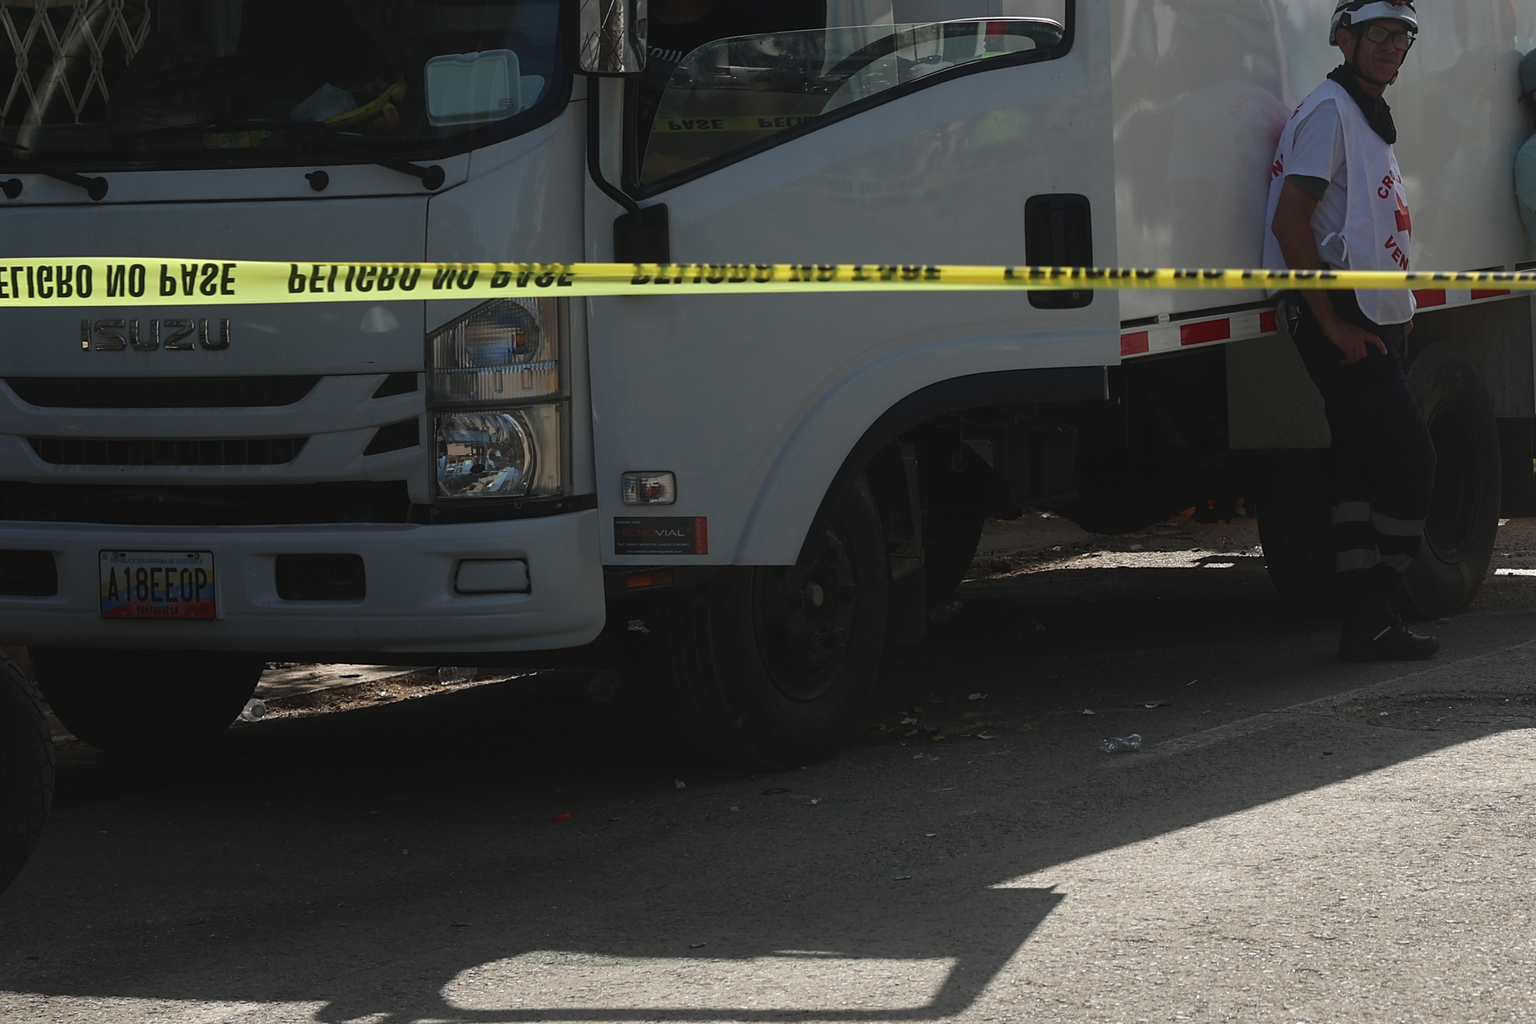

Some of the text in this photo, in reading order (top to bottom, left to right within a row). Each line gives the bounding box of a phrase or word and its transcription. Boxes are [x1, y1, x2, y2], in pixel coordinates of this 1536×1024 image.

[1384, 234, 1410, 272] VEN
[81, 318, 232, 352] ISUZU
[615, 528, 685, 537] TECNOVIAL
[136, 605, 179, 615] PORTUGUESA
